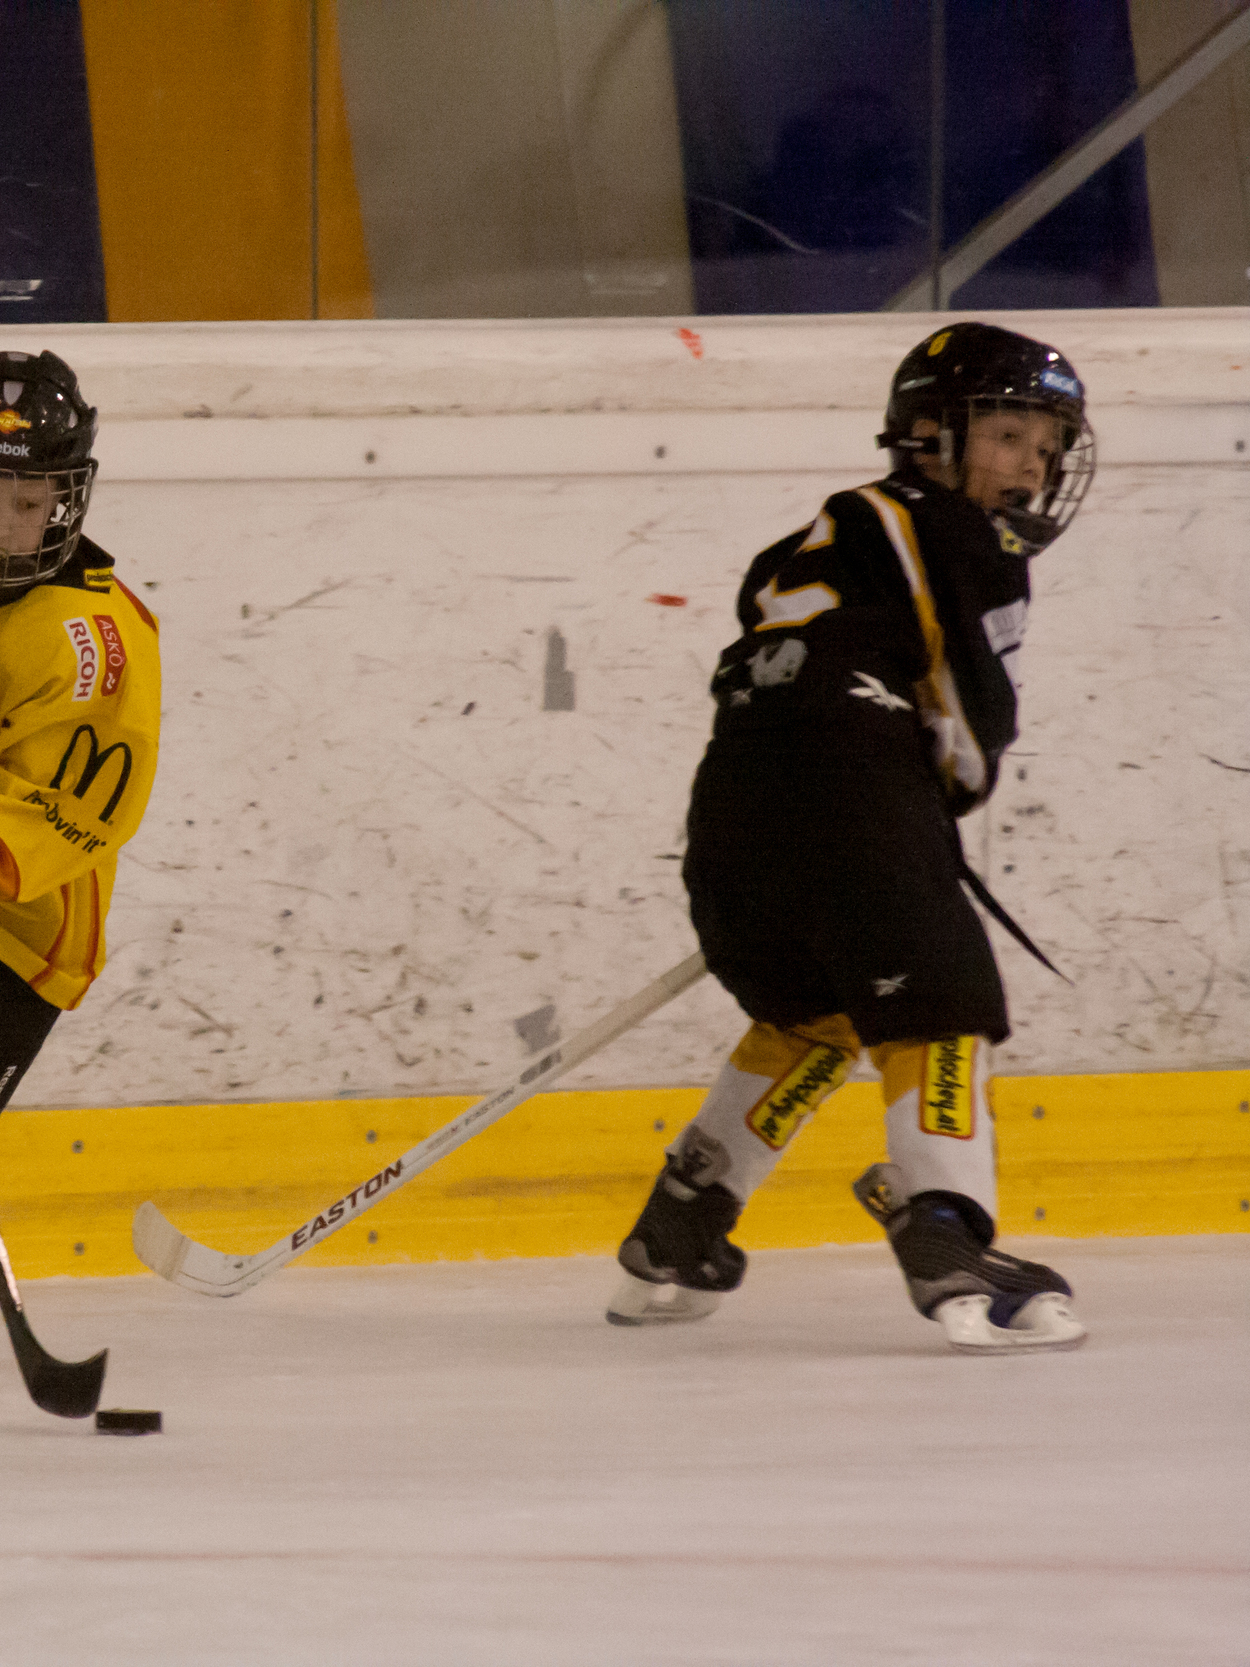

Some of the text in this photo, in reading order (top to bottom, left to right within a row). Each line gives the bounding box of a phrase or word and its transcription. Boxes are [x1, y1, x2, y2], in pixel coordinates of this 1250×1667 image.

[69, 621, 96, 698] RICOH
[99, 619, 124, 667] ASKO
[291, 1158, 404, 1251] EASTON
